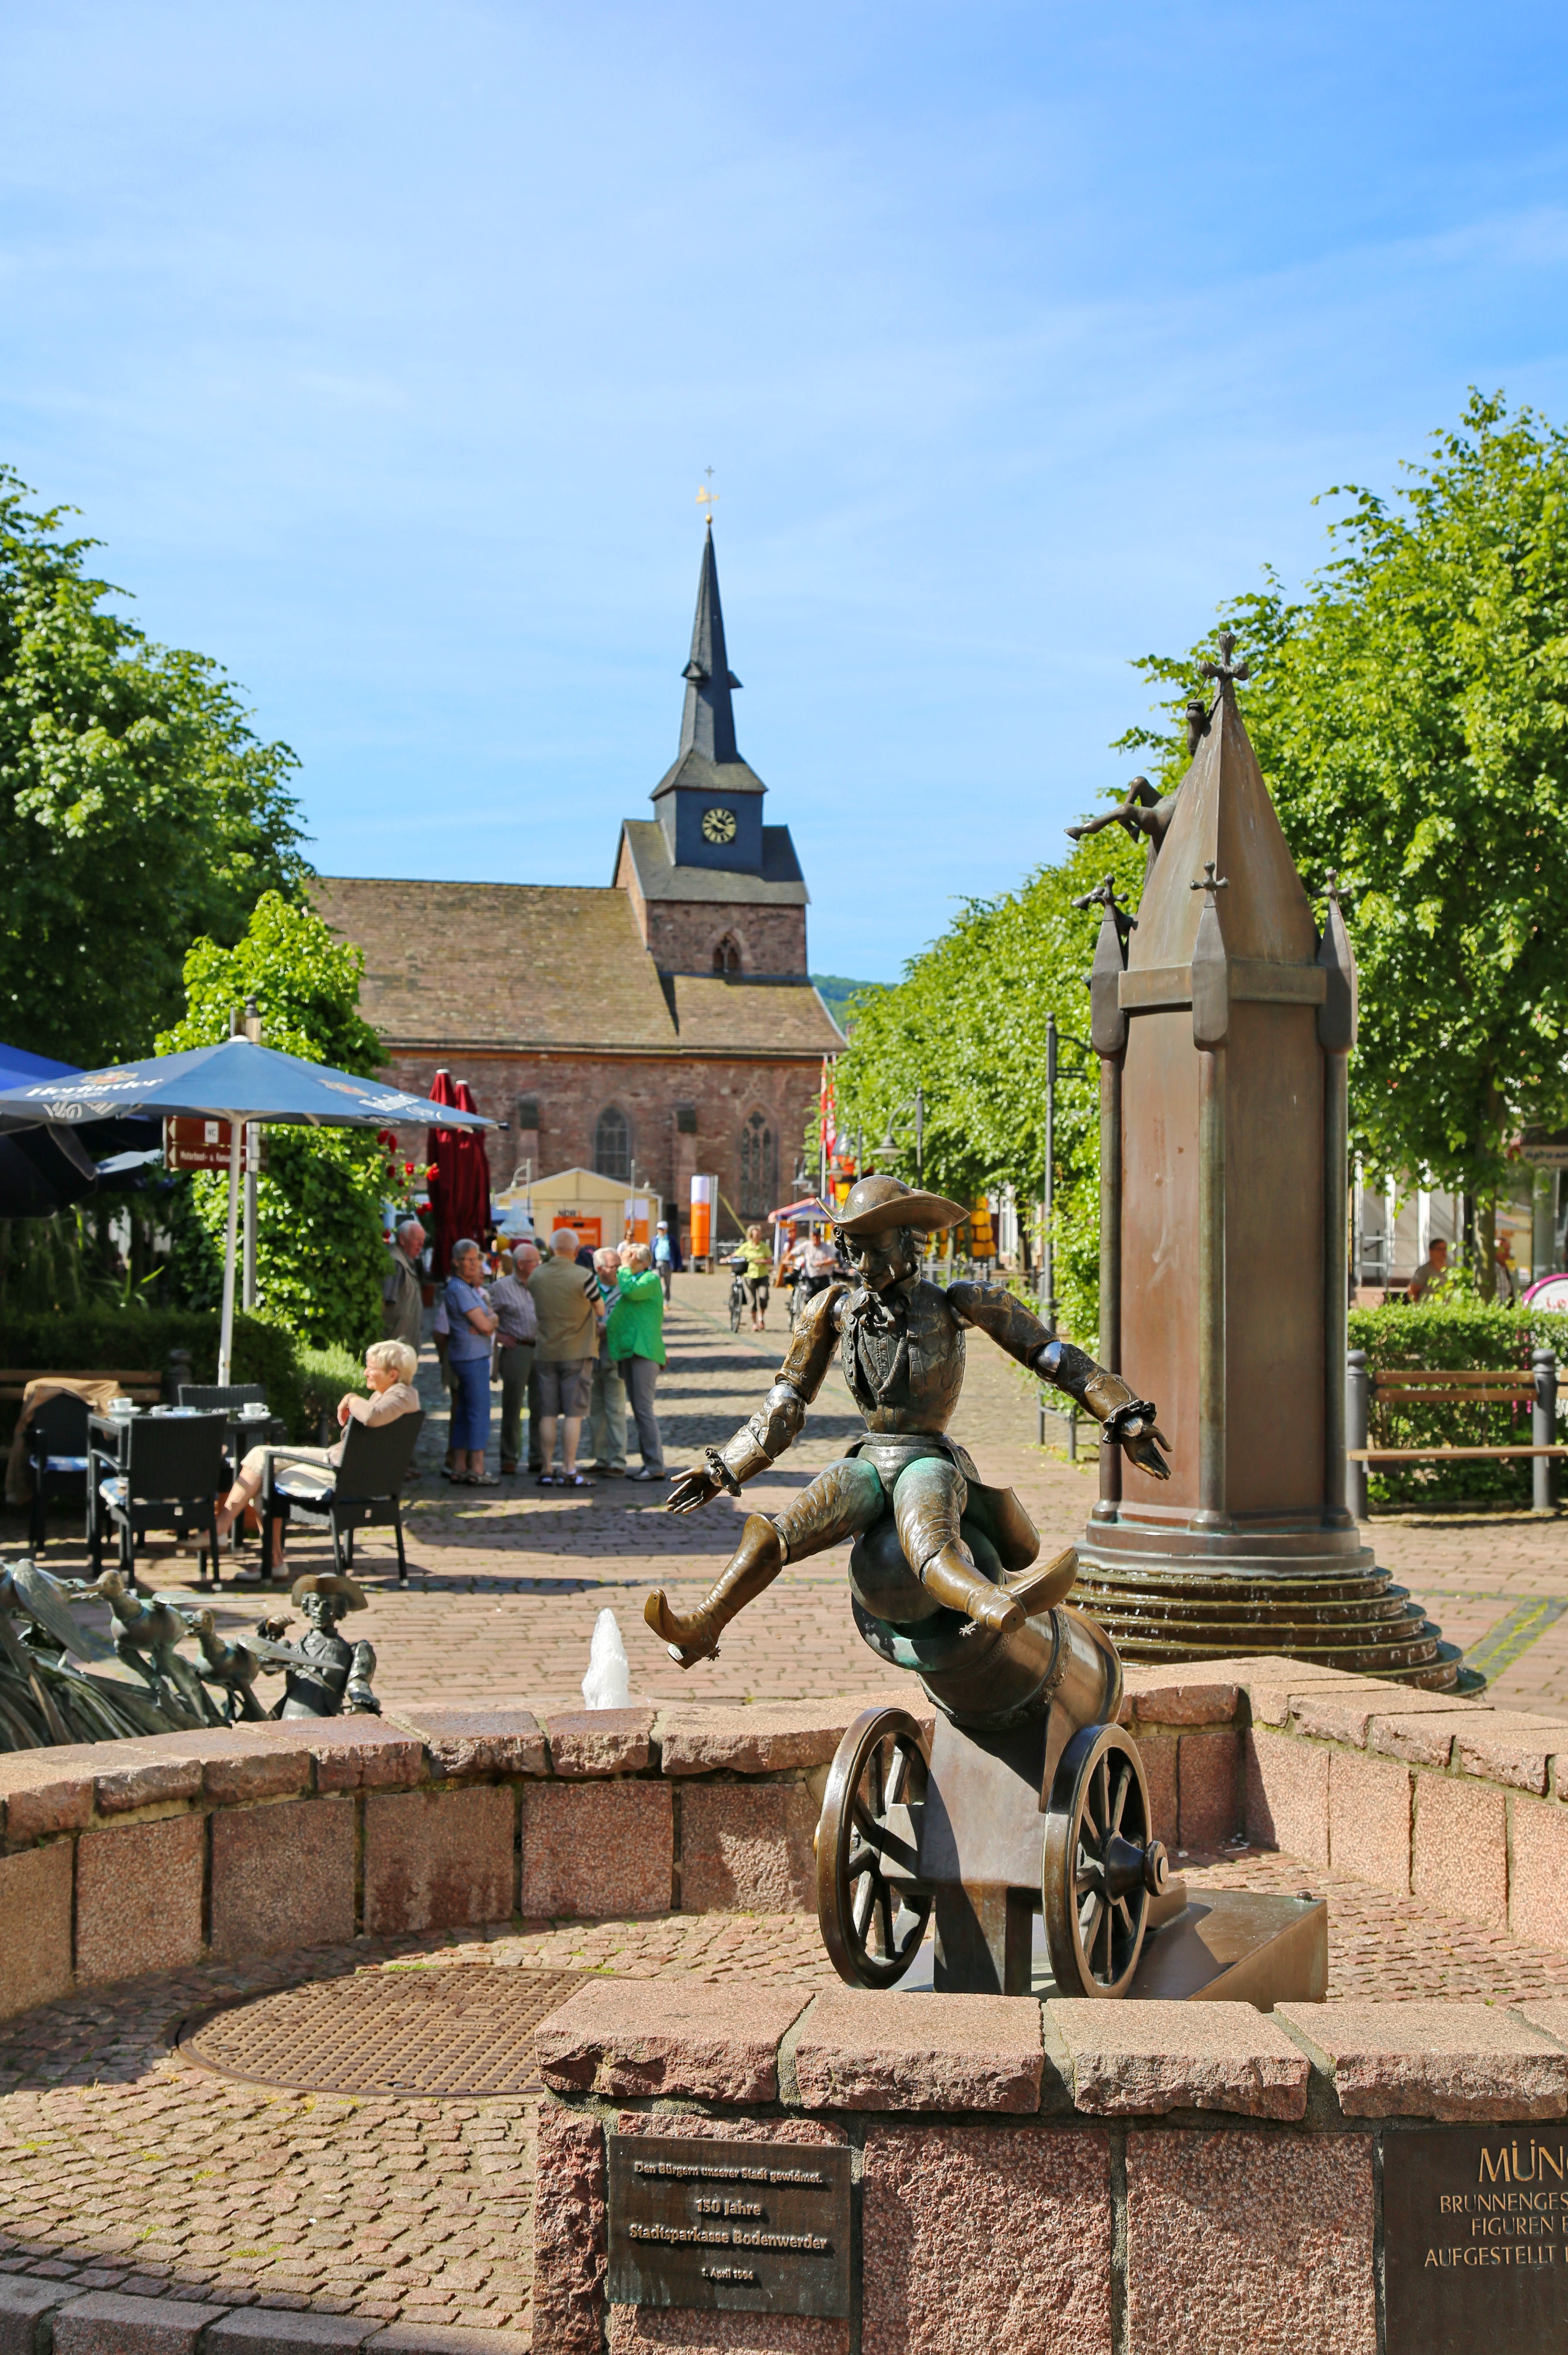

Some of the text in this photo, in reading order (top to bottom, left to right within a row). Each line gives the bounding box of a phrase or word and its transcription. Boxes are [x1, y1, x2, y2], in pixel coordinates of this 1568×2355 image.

[206, 1128, 216, 1137] WC
[180, 1150, 208, 1162] Motorboot-
[1479, 2139, 1568, 2183] MÜN
[635, 2161, 823, 2183] Den Bürgern unserer Stadt gewidmet.
[696, 2198, 761, 2216] 150 Jahre
[1440, 2192, 1568, 2213] BRUNNENGES
[1472, 2216, 1554, 2236] FIGUREN
[629, 2224, 828, 2250] Stadtsparkasse Bodenwerder
[1424, 2245, 1556, 2267] AUFGESTELLT
[701, 2267, 754, 2280] 1. April 1994
